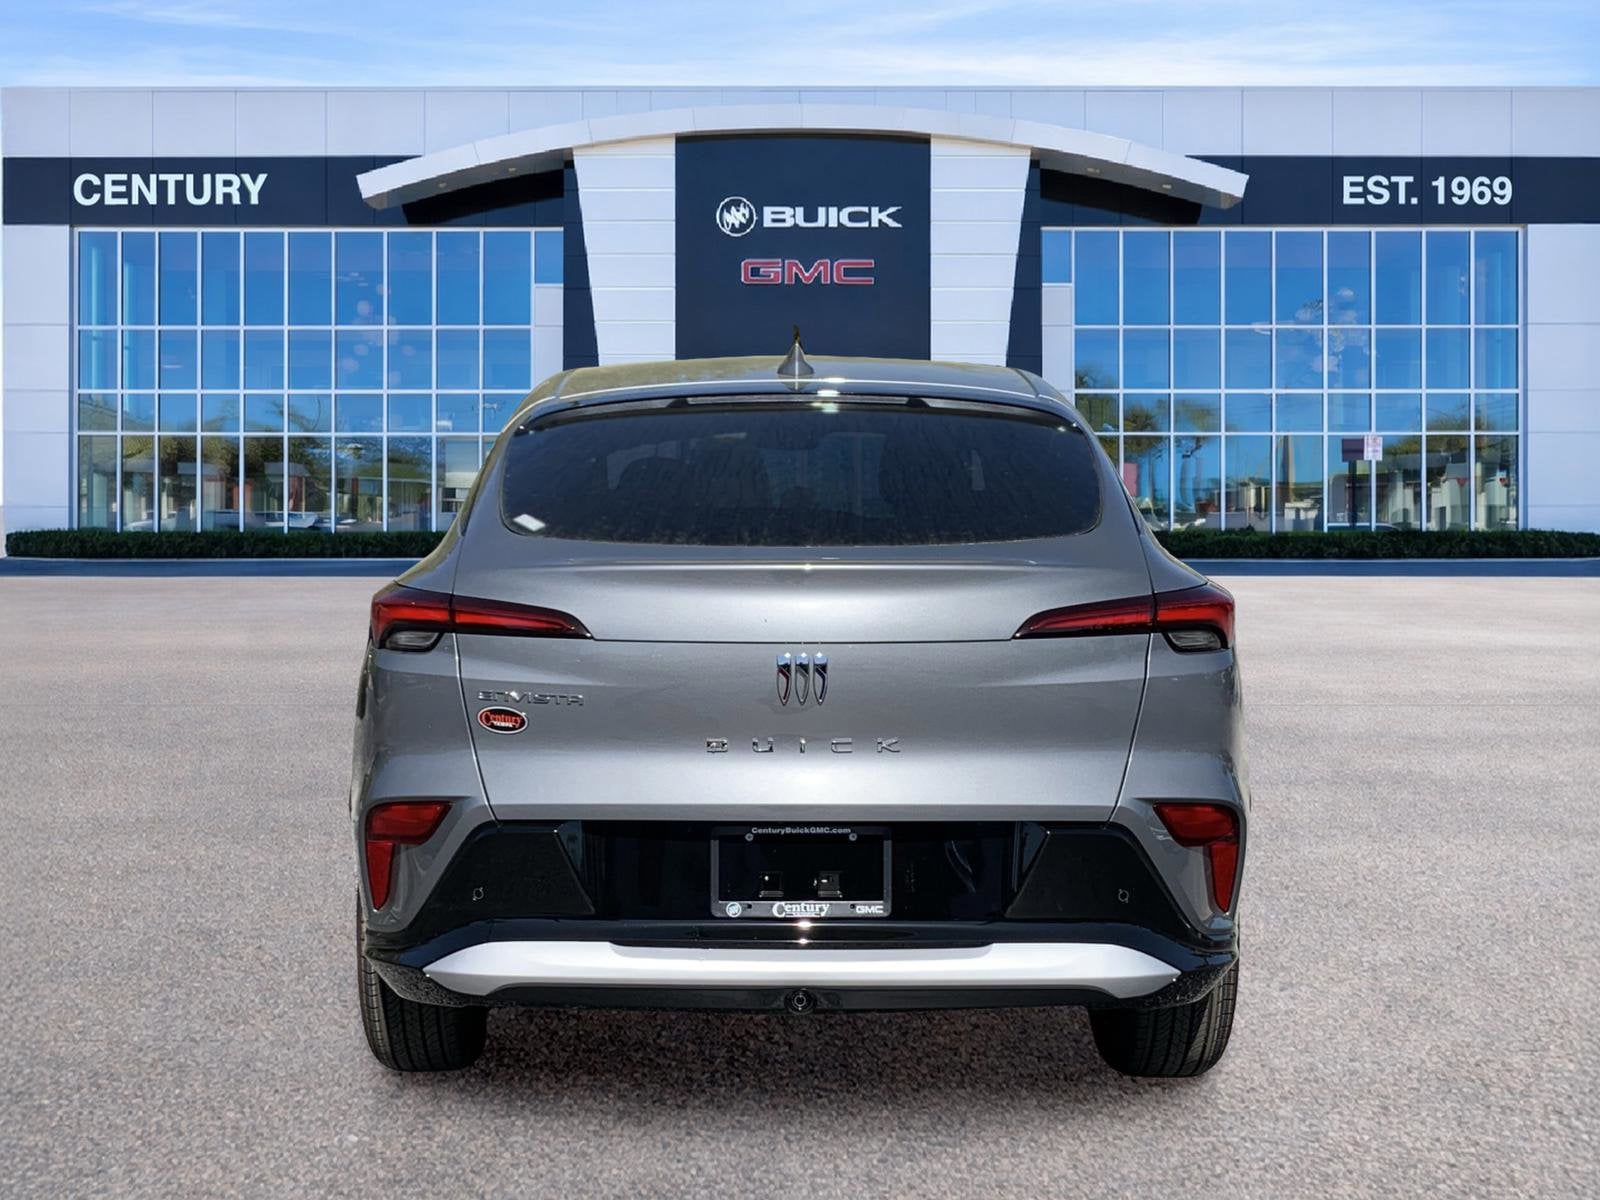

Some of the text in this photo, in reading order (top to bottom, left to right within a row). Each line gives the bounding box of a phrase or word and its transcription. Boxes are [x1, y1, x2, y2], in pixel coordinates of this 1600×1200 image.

[73, 172, 268, 206] CENTURY
[1342, 174, 1513, 205] EST. 1969
[762, 206, 903, 228] BUICK
[741, 258, 875, 285] GMC
[478, 690, 584, 707] ENVISTA
[481, 710, 522, 729] Century
[706, 737, 901, 754] BUICK
[751, 827, 851, 835] CenturyBuickGMC.com
[772, 901, 831, 918] Century
[855, 905, 884, 914] GMC
